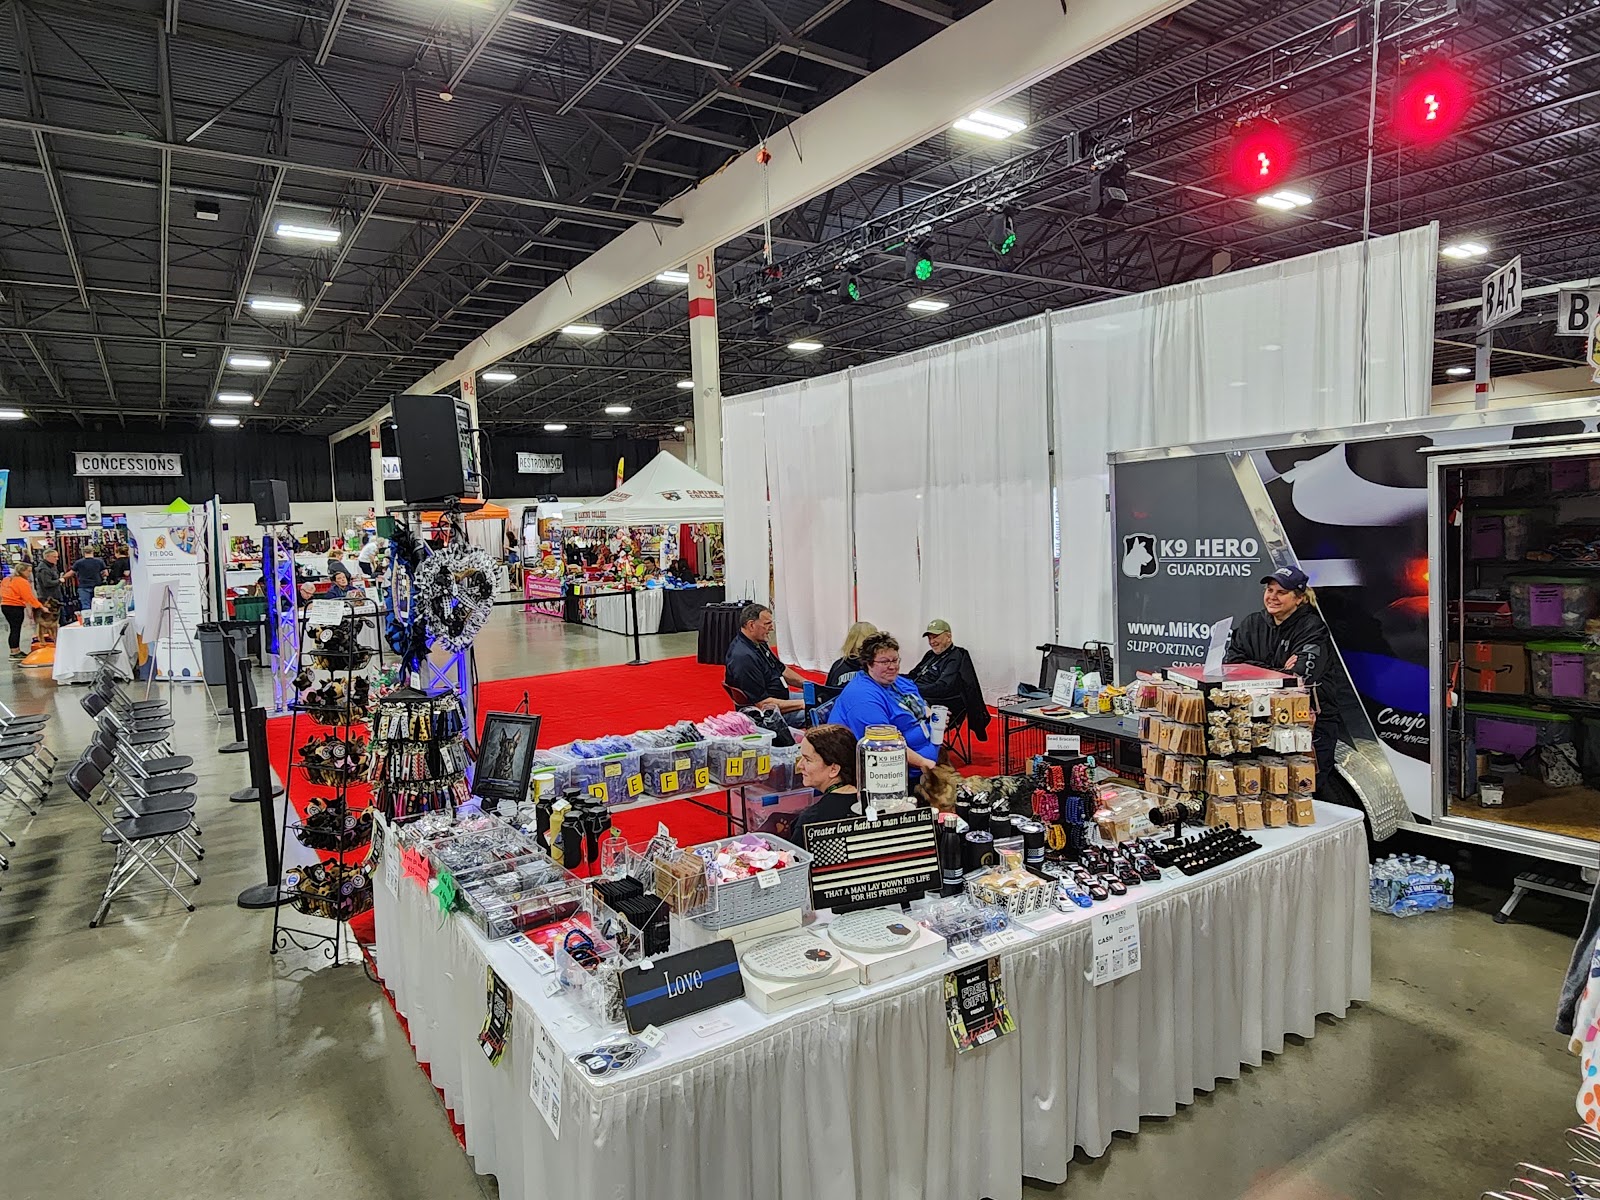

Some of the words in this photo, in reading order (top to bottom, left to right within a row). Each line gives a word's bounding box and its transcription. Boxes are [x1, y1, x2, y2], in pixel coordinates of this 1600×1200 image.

[1486, 266, 1517, 323] BAR
[82, 457, 175, 471] CONCESSIONS
[519, 457, 555, 469] RESTROOMS
[1160, 539, 1188, 557] K9
[1195, 537, 1259, 557] HERO
[1166, 563, 1252, 577] GUARDIANS
[1126, 639, 1205, 658] SUPPORTING
[1377, 707, 1426, 733] Canjo
[761, 759, 767, 771] J
[889, 754, 905, 762] HERO
[730, 760, 740, 774] H
[665, 774, 673, 788] F
[697, 770, 707, 784] G
[869, 771, 904, 780] Donations
[631, 776, 640, 791] E
[807, 827, 836, 841] Greater
[836, 822, 853, 835] love
[853, 820, 872, 832] hath
[871, 820, 882, 829] no
[882, 819, 899, 828] man
[899, 814, 917, 826] than
[917, 810, 932, 822] this
[823, 888, 844, 899] THAT
[844, 887, 851, 896] A
[850, 885, 868, 896] MAN
[867, 883, 882, 892] LAY
[881, 880, 903, 890] DOWN
[903, 876, 916, 886] HIS
[915, 873, 931, 884] LIFE
[851, 893, 866, 903] FOR
[865, 891, 878, 900] HIS
[878, 886, 908, 898] FRIENDS
[1097, 934, 1114, 946] CASH
[663, 969, 704, 999] Love
[966, 975, 980, 985] BLACK
[961, 980, 988, 1000] FREE
[962, 991, 989, 1010] GIFT!
[969, 1005, 985, 1016] FRIDAY
